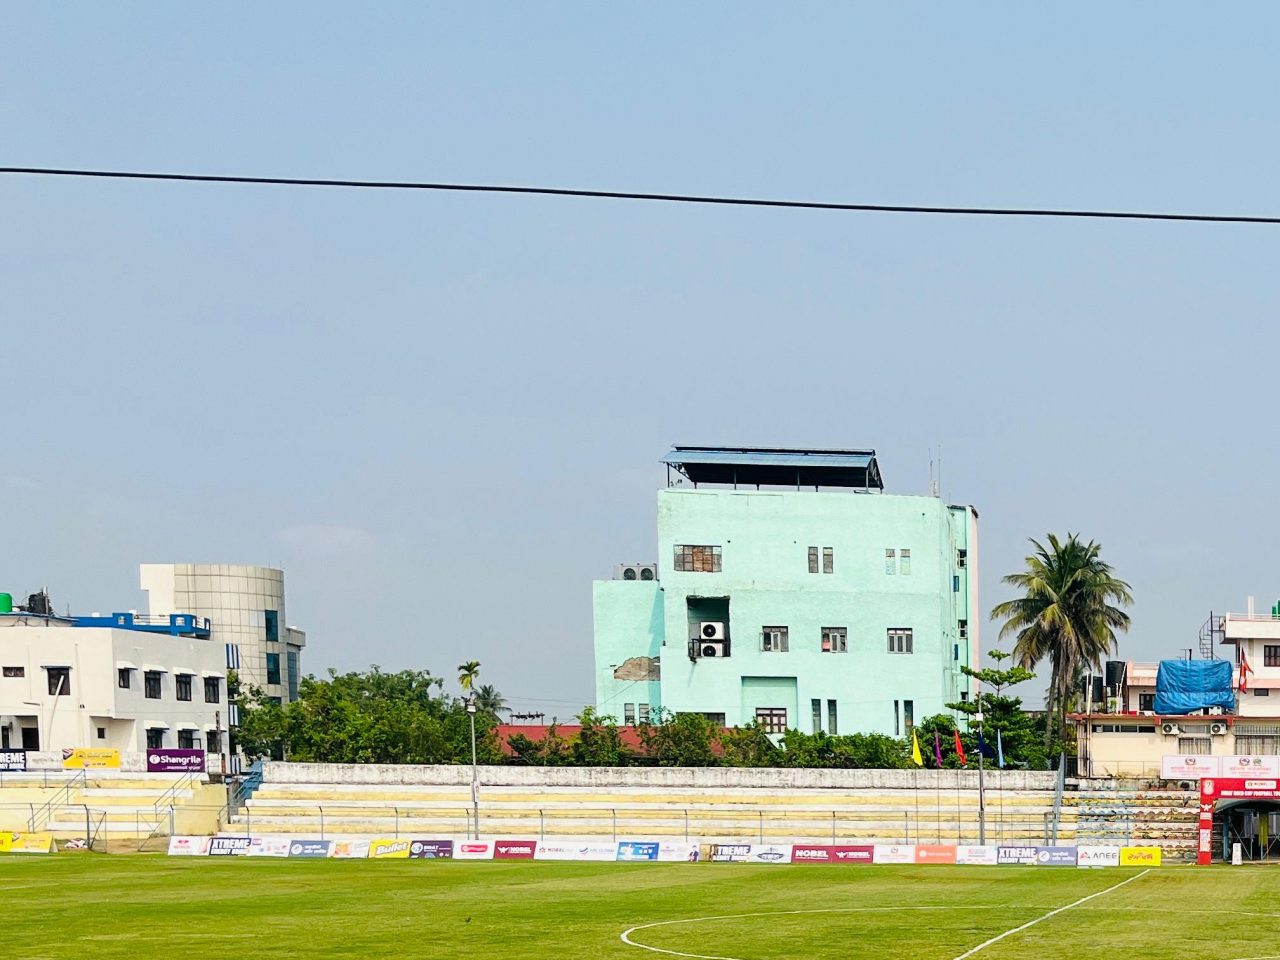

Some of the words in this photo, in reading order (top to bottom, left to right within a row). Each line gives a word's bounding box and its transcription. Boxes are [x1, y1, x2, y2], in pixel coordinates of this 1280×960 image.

[161, 755, 201, 765] Shangrila
[212, 839, 248, 849] XTREME
[376, 842, 408, 855] Bullet
[999, 847, 1037, 858] XTREME
